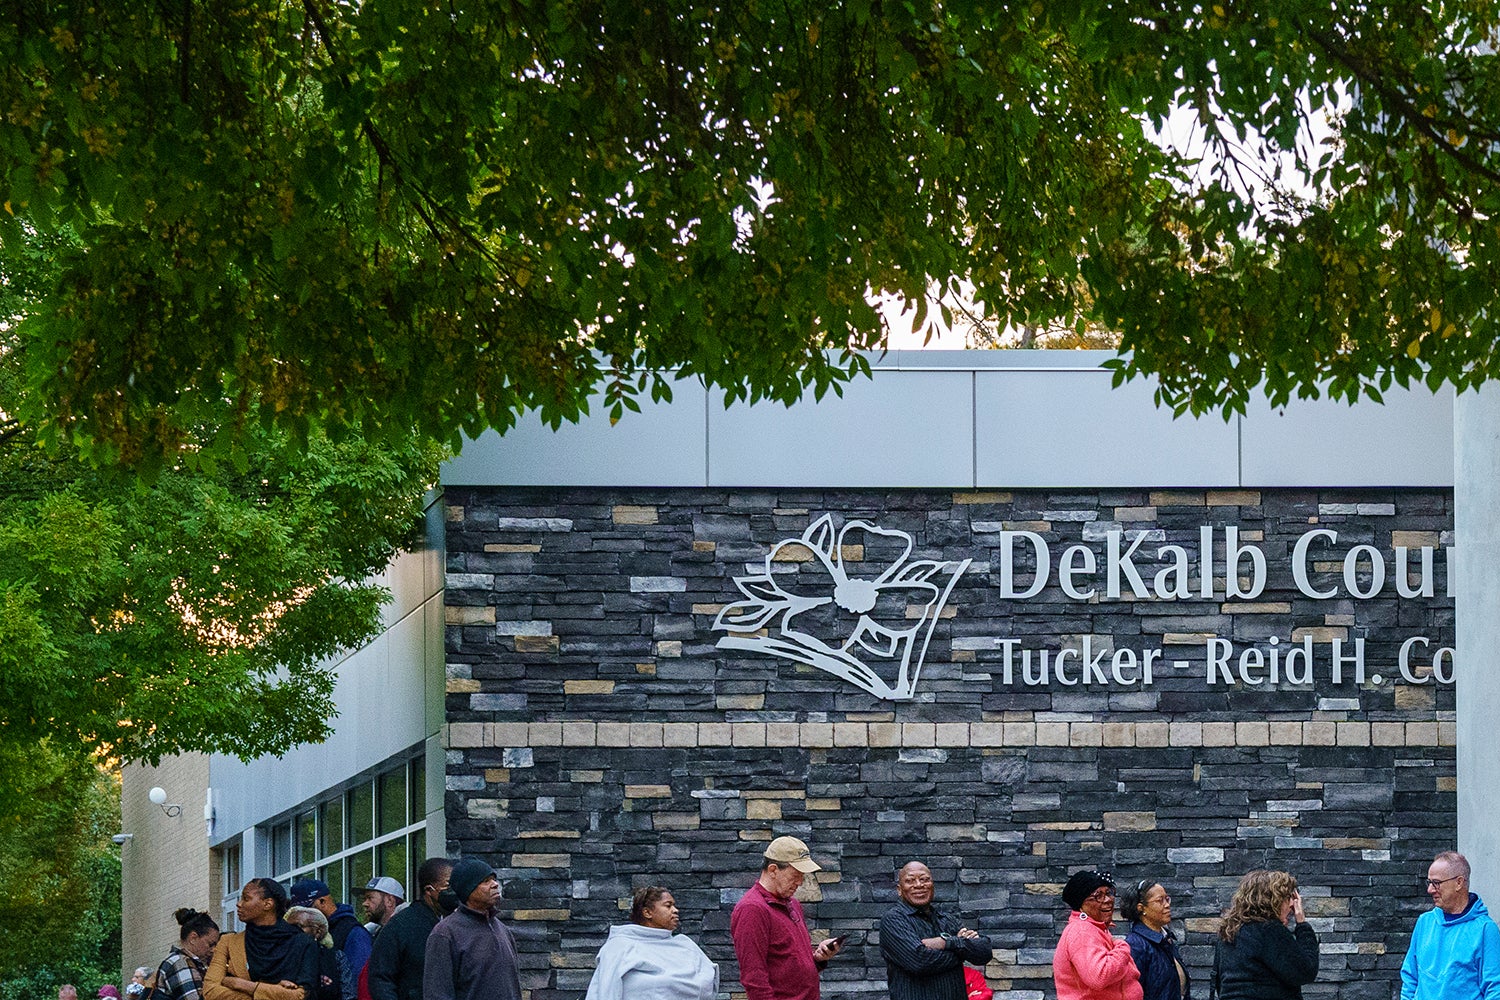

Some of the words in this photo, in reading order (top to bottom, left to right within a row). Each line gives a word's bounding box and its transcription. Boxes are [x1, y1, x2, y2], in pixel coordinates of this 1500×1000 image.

[999, 525, 1267, 600] DeKalb
[992, 635, 1161, 686] Tucker
[1206, 634, 1313, 685] Reid
[1332, 637, 1380, 685] H.
